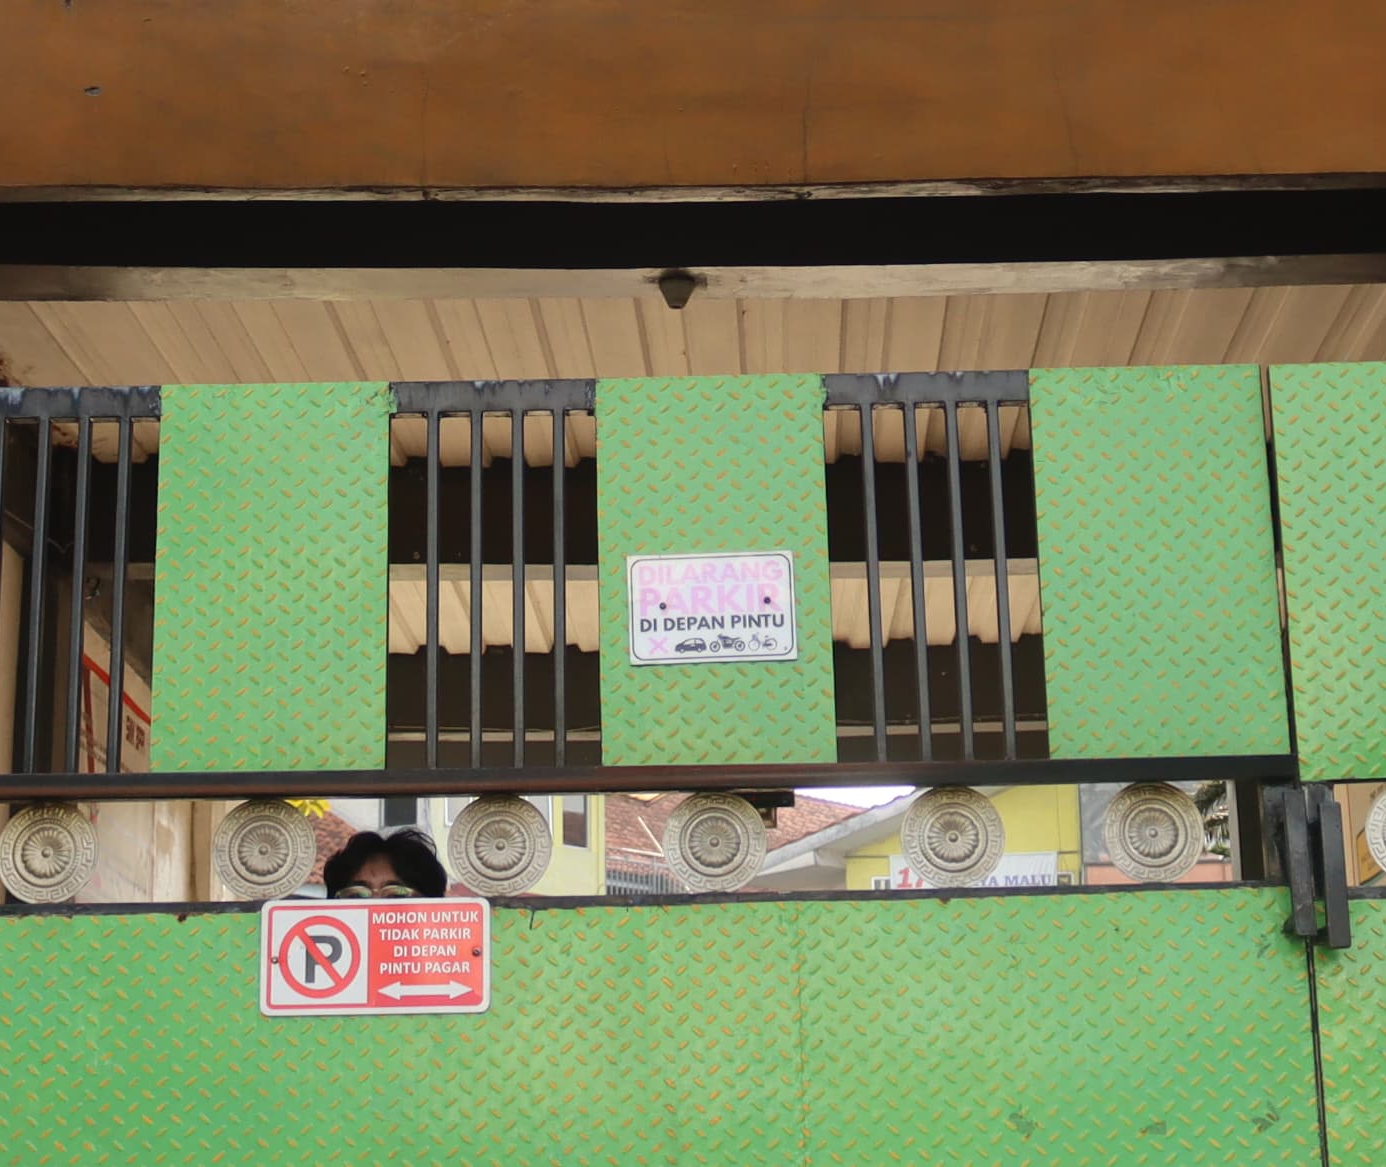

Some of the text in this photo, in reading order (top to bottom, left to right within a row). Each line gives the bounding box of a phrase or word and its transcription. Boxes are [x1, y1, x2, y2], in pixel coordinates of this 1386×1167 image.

[638, 560, 783, 585] DILARANG
[639, 583, 783, 616] PARKIR
[640, 614, 784, 632] DI DEPAN PINTU
[1005, 874, 1052, 887] MALU
[372, 911, 479, 924] MOHON UNTUK
[379, 928, 471, 940] TIDAK PARKIR
[393, 945, 456, 957] DI DEPAN
[380, 961, 470, 974] PINTU PAGAR
